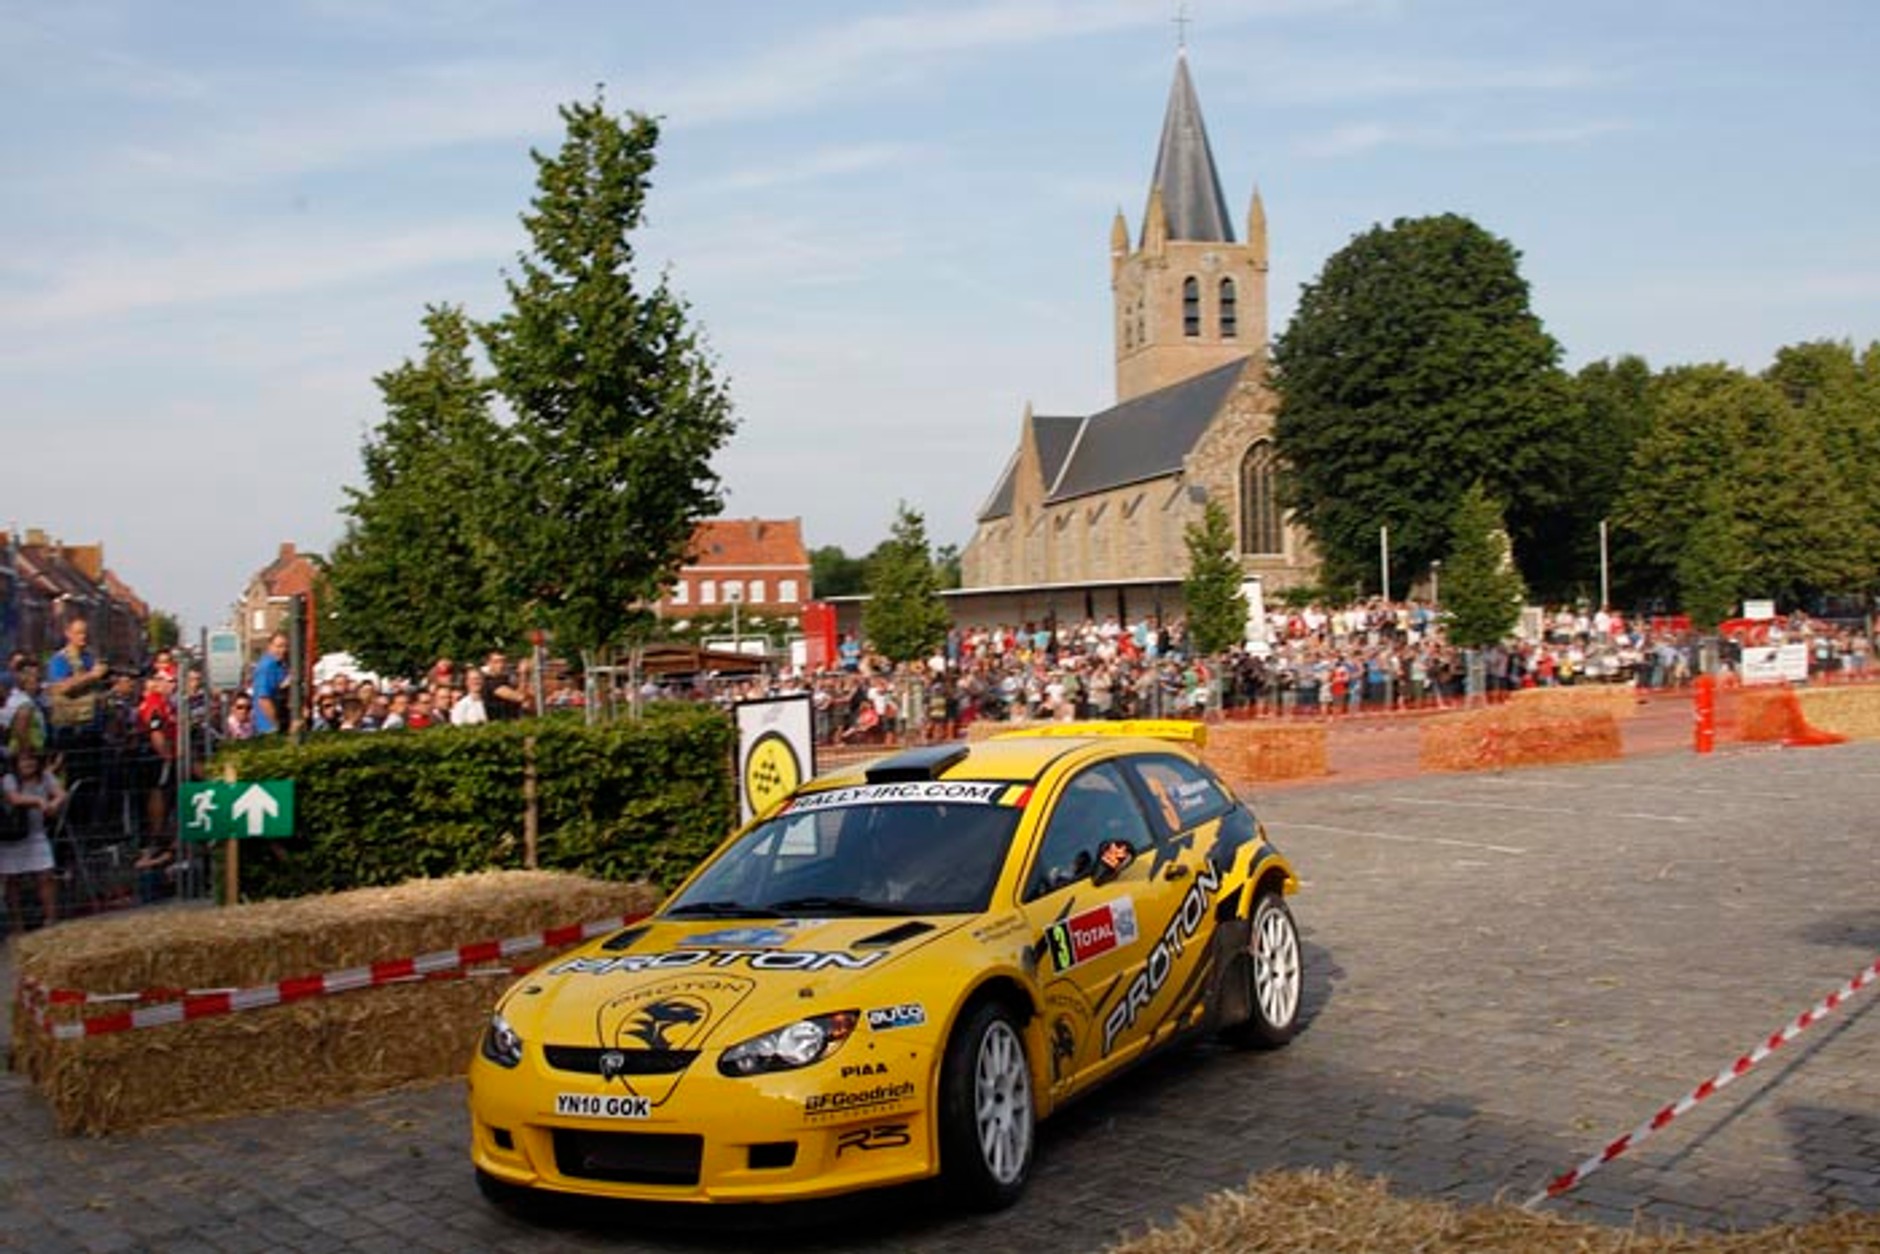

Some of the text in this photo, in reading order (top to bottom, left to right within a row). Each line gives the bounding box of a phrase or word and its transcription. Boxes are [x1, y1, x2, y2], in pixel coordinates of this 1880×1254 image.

[1053, 925, 1070, 970] 3
[1103, 857, 1221, 1056] PROTON
[547, 950, 889, 975] PROTON
[840, 1062, 888, 1078] PIAA
[558, 1095, 648, 1116] YN10 GOK
[804, 1081, 915, 1110] BFGoodrich
